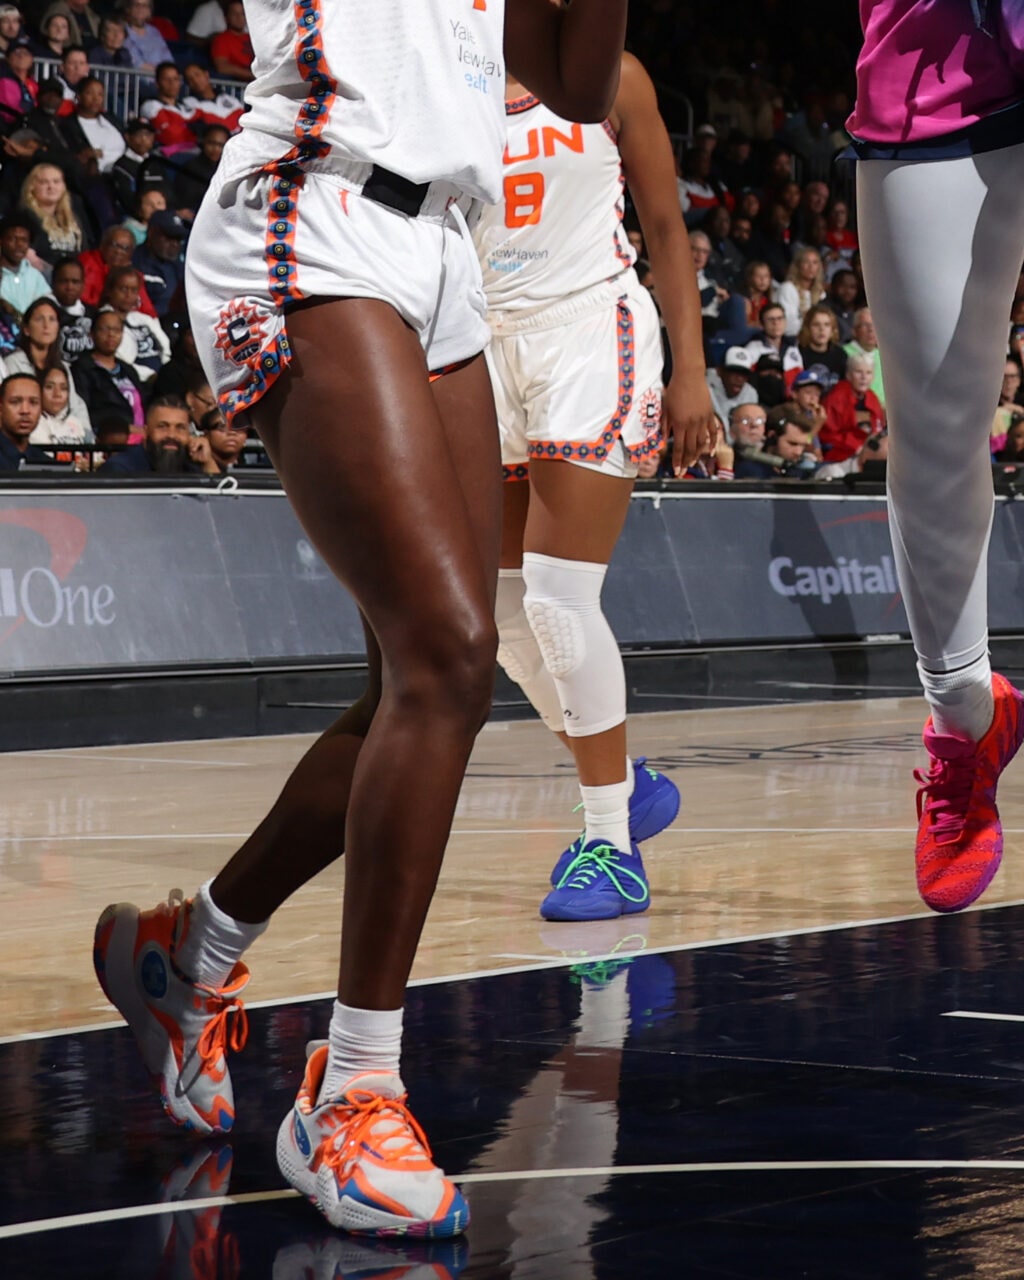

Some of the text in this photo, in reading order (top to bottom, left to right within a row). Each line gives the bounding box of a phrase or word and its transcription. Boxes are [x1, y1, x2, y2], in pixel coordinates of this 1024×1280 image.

[502, 122, 584, 165] UN
[503, 172, 545, 229] 8
[768, 555, 897, 605] Capital
